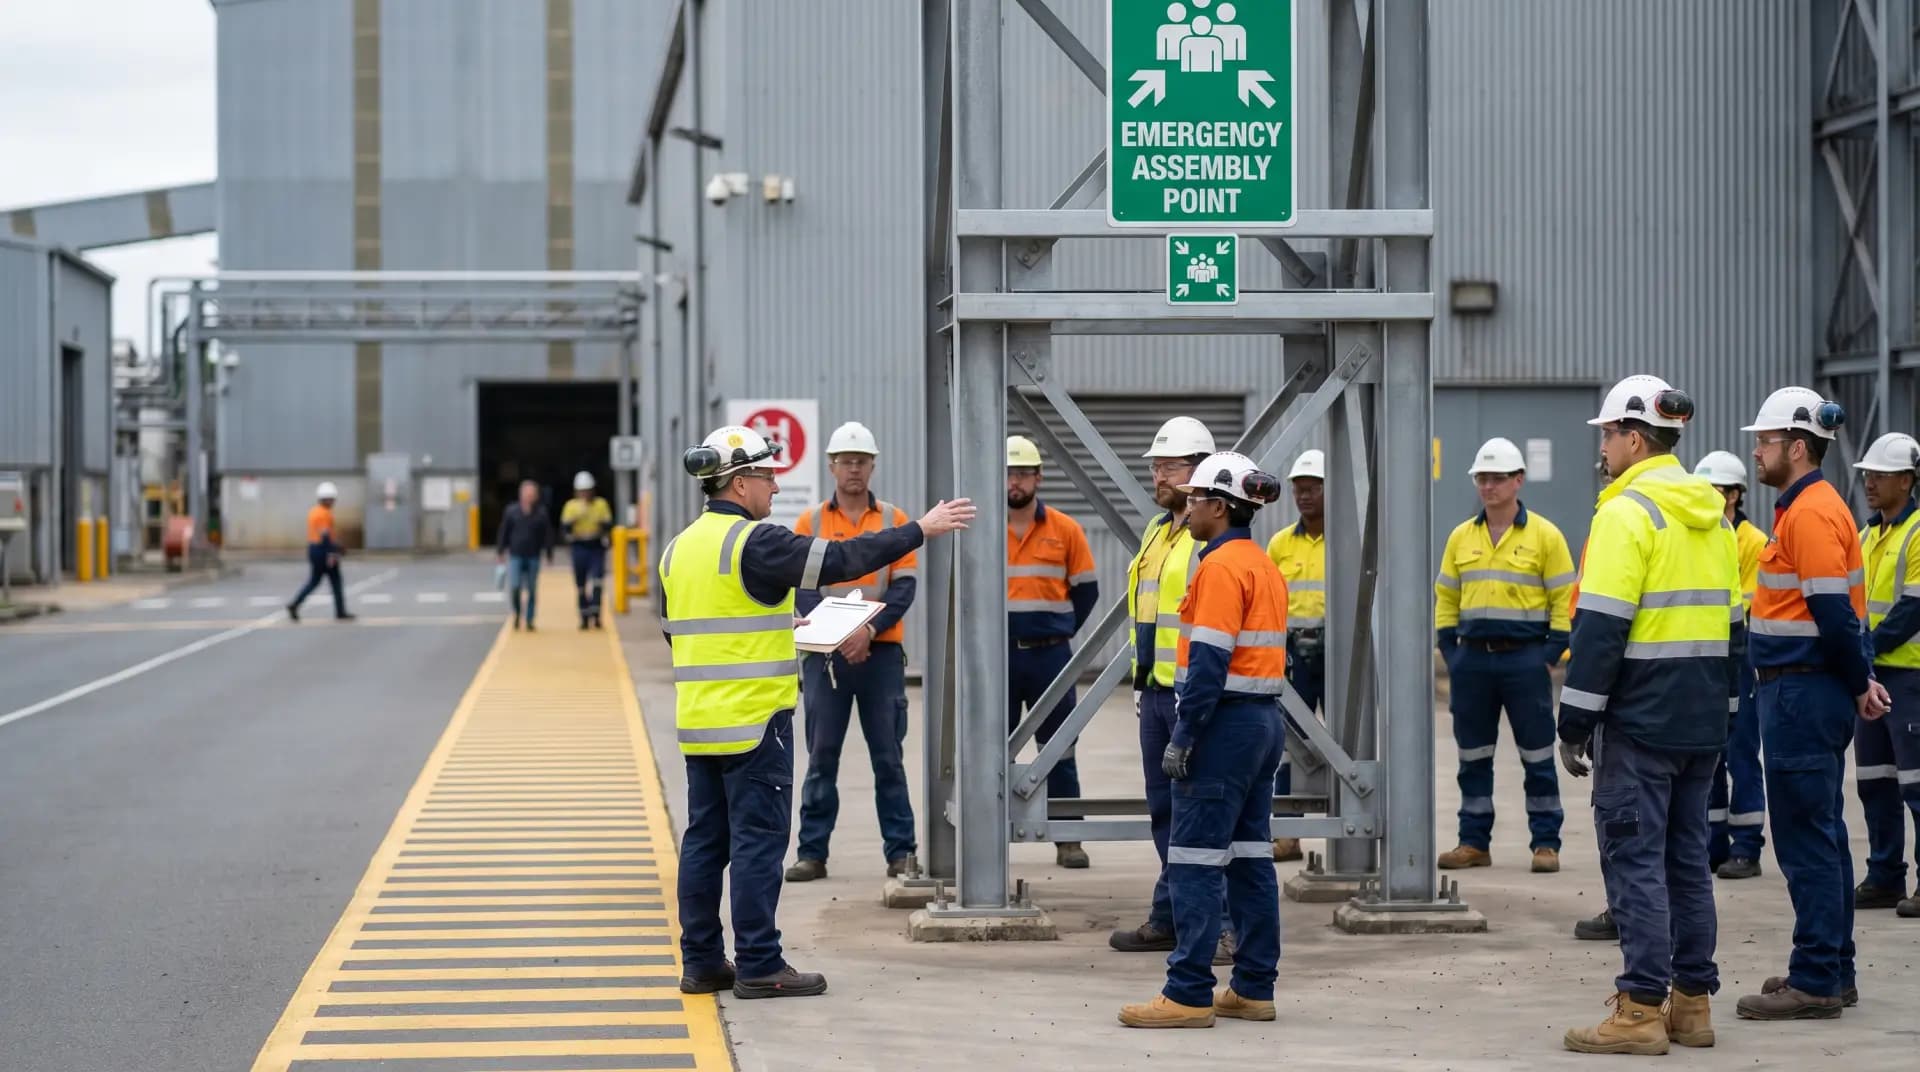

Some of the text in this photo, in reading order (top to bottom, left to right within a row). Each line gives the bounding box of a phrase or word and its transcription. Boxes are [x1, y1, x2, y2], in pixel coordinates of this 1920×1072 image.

[1121, 121, 1283, 147] EMERGENCY
[1131, 154, 1272, 181] ASSEMBLY
[1163, 187, 1242, 214] POINT
